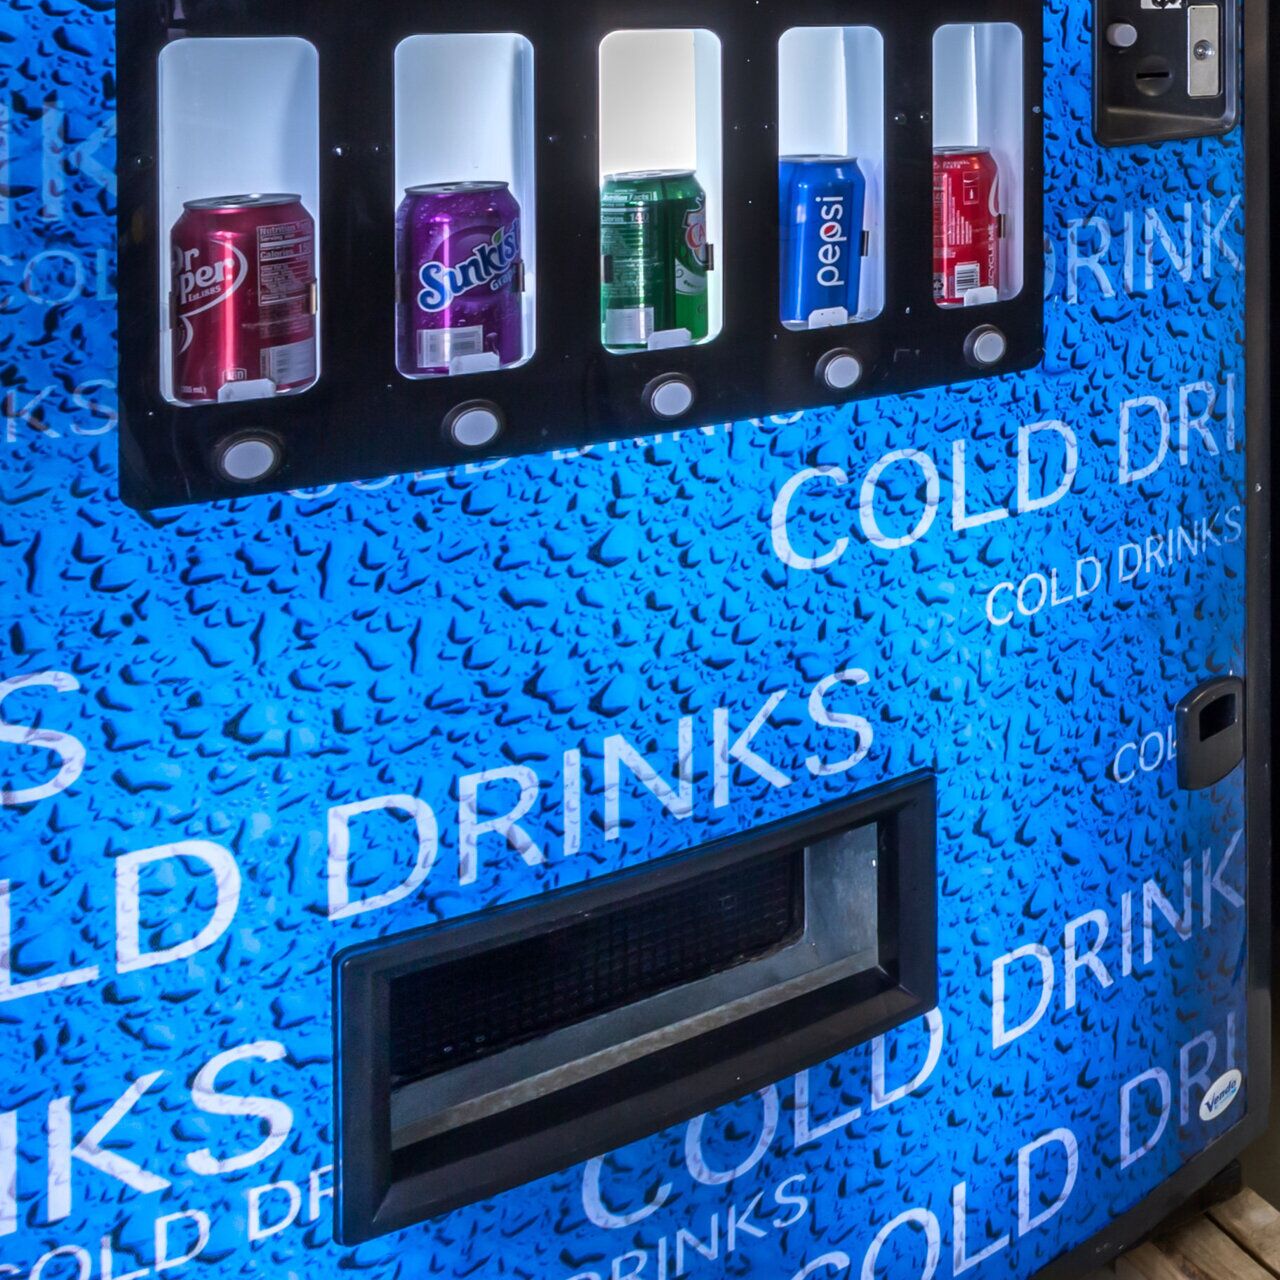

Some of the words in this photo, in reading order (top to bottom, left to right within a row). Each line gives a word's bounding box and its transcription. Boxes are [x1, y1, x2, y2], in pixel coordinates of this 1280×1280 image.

[815, 195, 844, 288] pepsi
[771, 419, 1078, 571] COLD
[985, 557, 1102, 626] COLD
[1117, 505, 1243, 583] DRINKS
[327, 667, 875, 921] DRINKS
[0, 1208, 211, 1280] OLD
